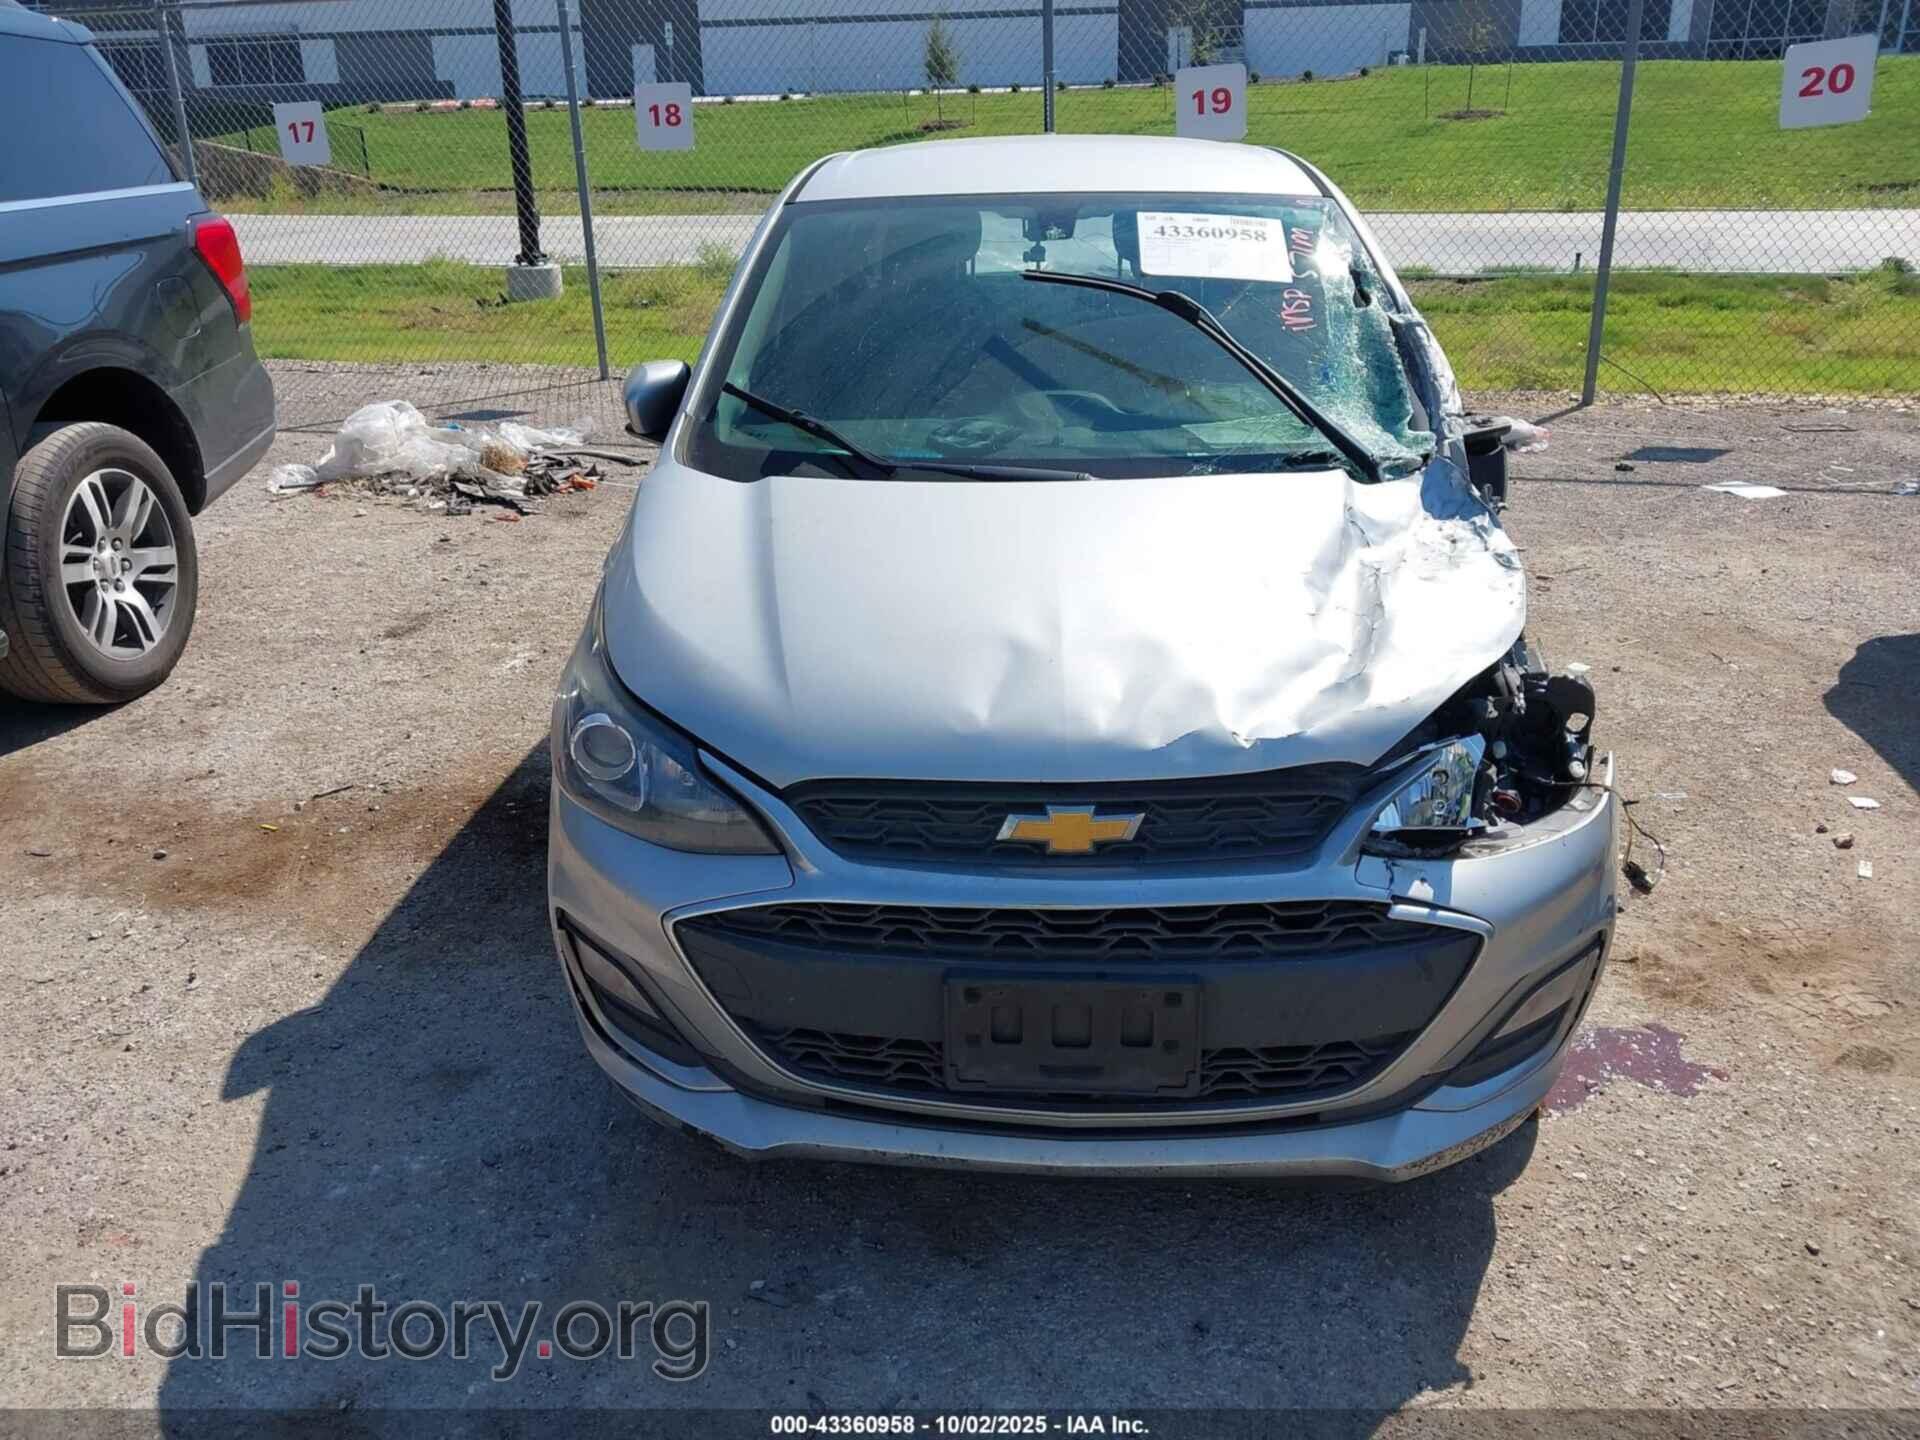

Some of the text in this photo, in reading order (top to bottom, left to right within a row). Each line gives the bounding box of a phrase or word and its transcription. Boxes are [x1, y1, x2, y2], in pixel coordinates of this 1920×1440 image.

[1799, 64, 1855, 97] 20
[1192, 87, 1232, 115] 19
[649, 103, 682, 128] 18
[288, 121, 315, 144] 17
[1153, 224, 1268, 242] 43360958
